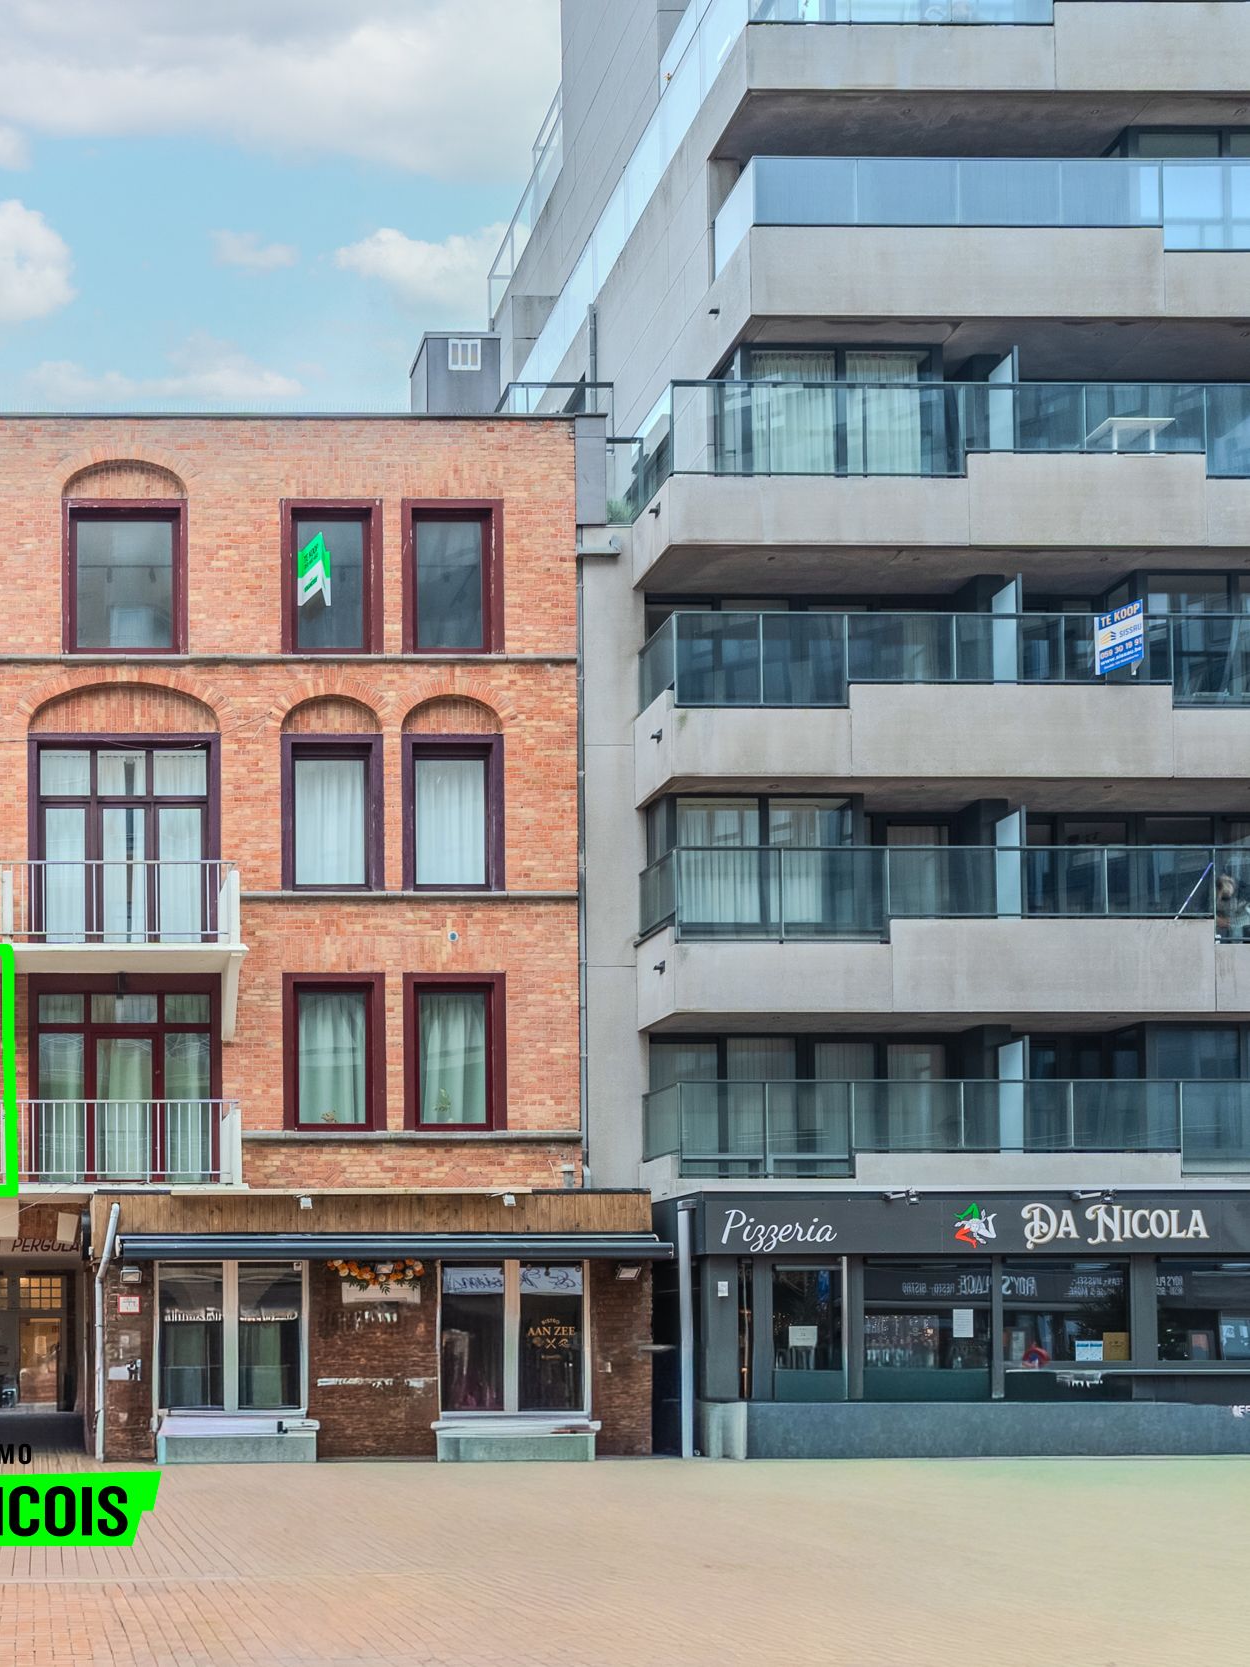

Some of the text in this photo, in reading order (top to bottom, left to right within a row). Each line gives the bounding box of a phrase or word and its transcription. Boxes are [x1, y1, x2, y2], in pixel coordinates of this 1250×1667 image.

[1101, 602, 1140, 627] TE KOOP
[1119, 623, 1142, 637] SISSAU
[1101, 649, 1113, 659] 059
[1114, 644, 1124, 654] 30
[721, 1209, 838, 1252] Pizzeria
[541, 1317, 560, 1325] BISTRO
[527, 1326, 576, 1336] AAN ZEE
